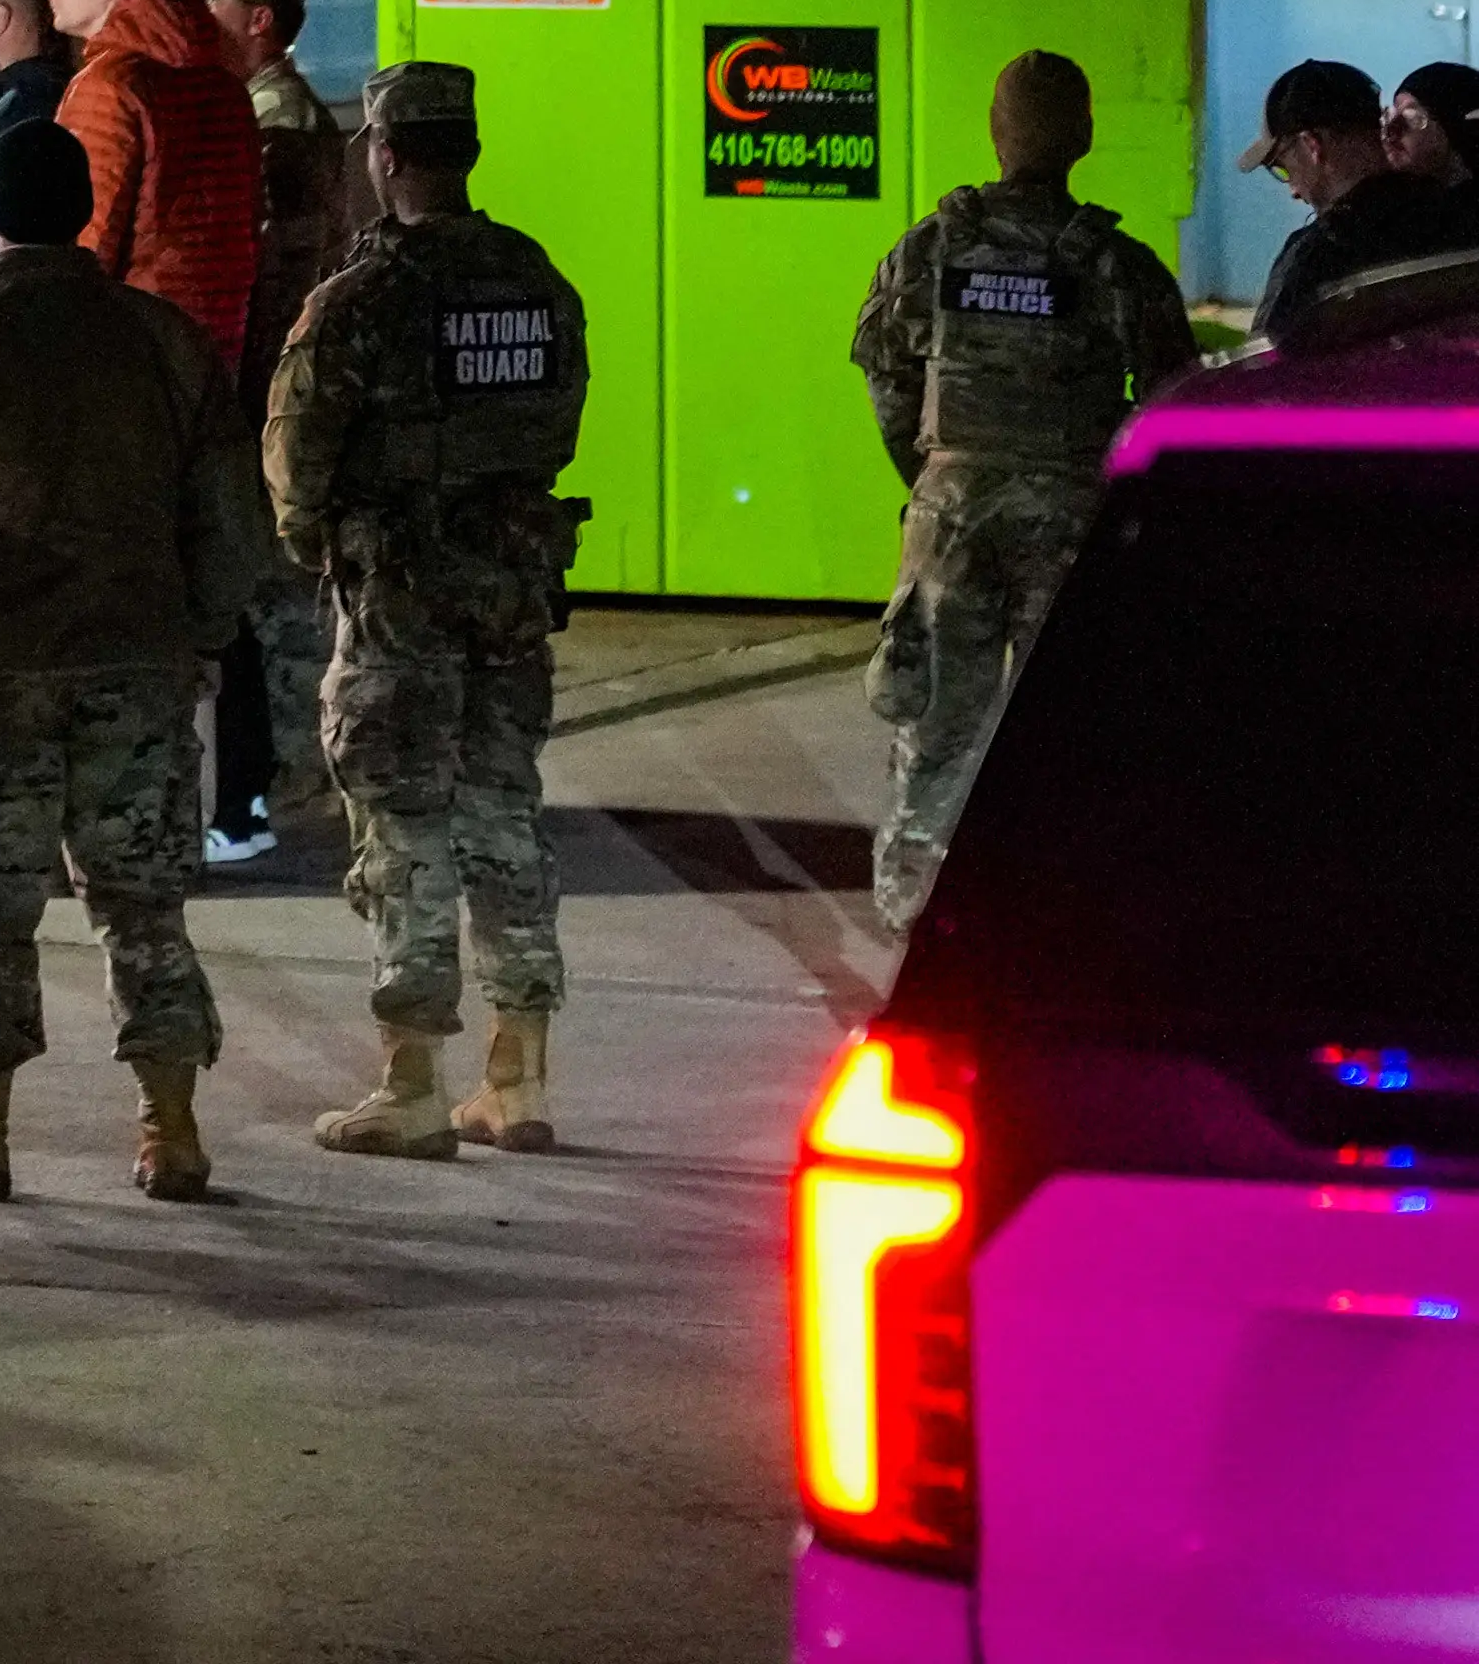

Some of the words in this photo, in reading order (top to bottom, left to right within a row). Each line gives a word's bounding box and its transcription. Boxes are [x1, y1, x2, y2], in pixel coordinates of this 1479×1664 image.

[708, 133, 875, 168] 410-768-1900
[970, 273, 1050, 293] MILITARY
[960, 289, 1055, 315] POLICE
[456, 348, 544, 385] GUARD
